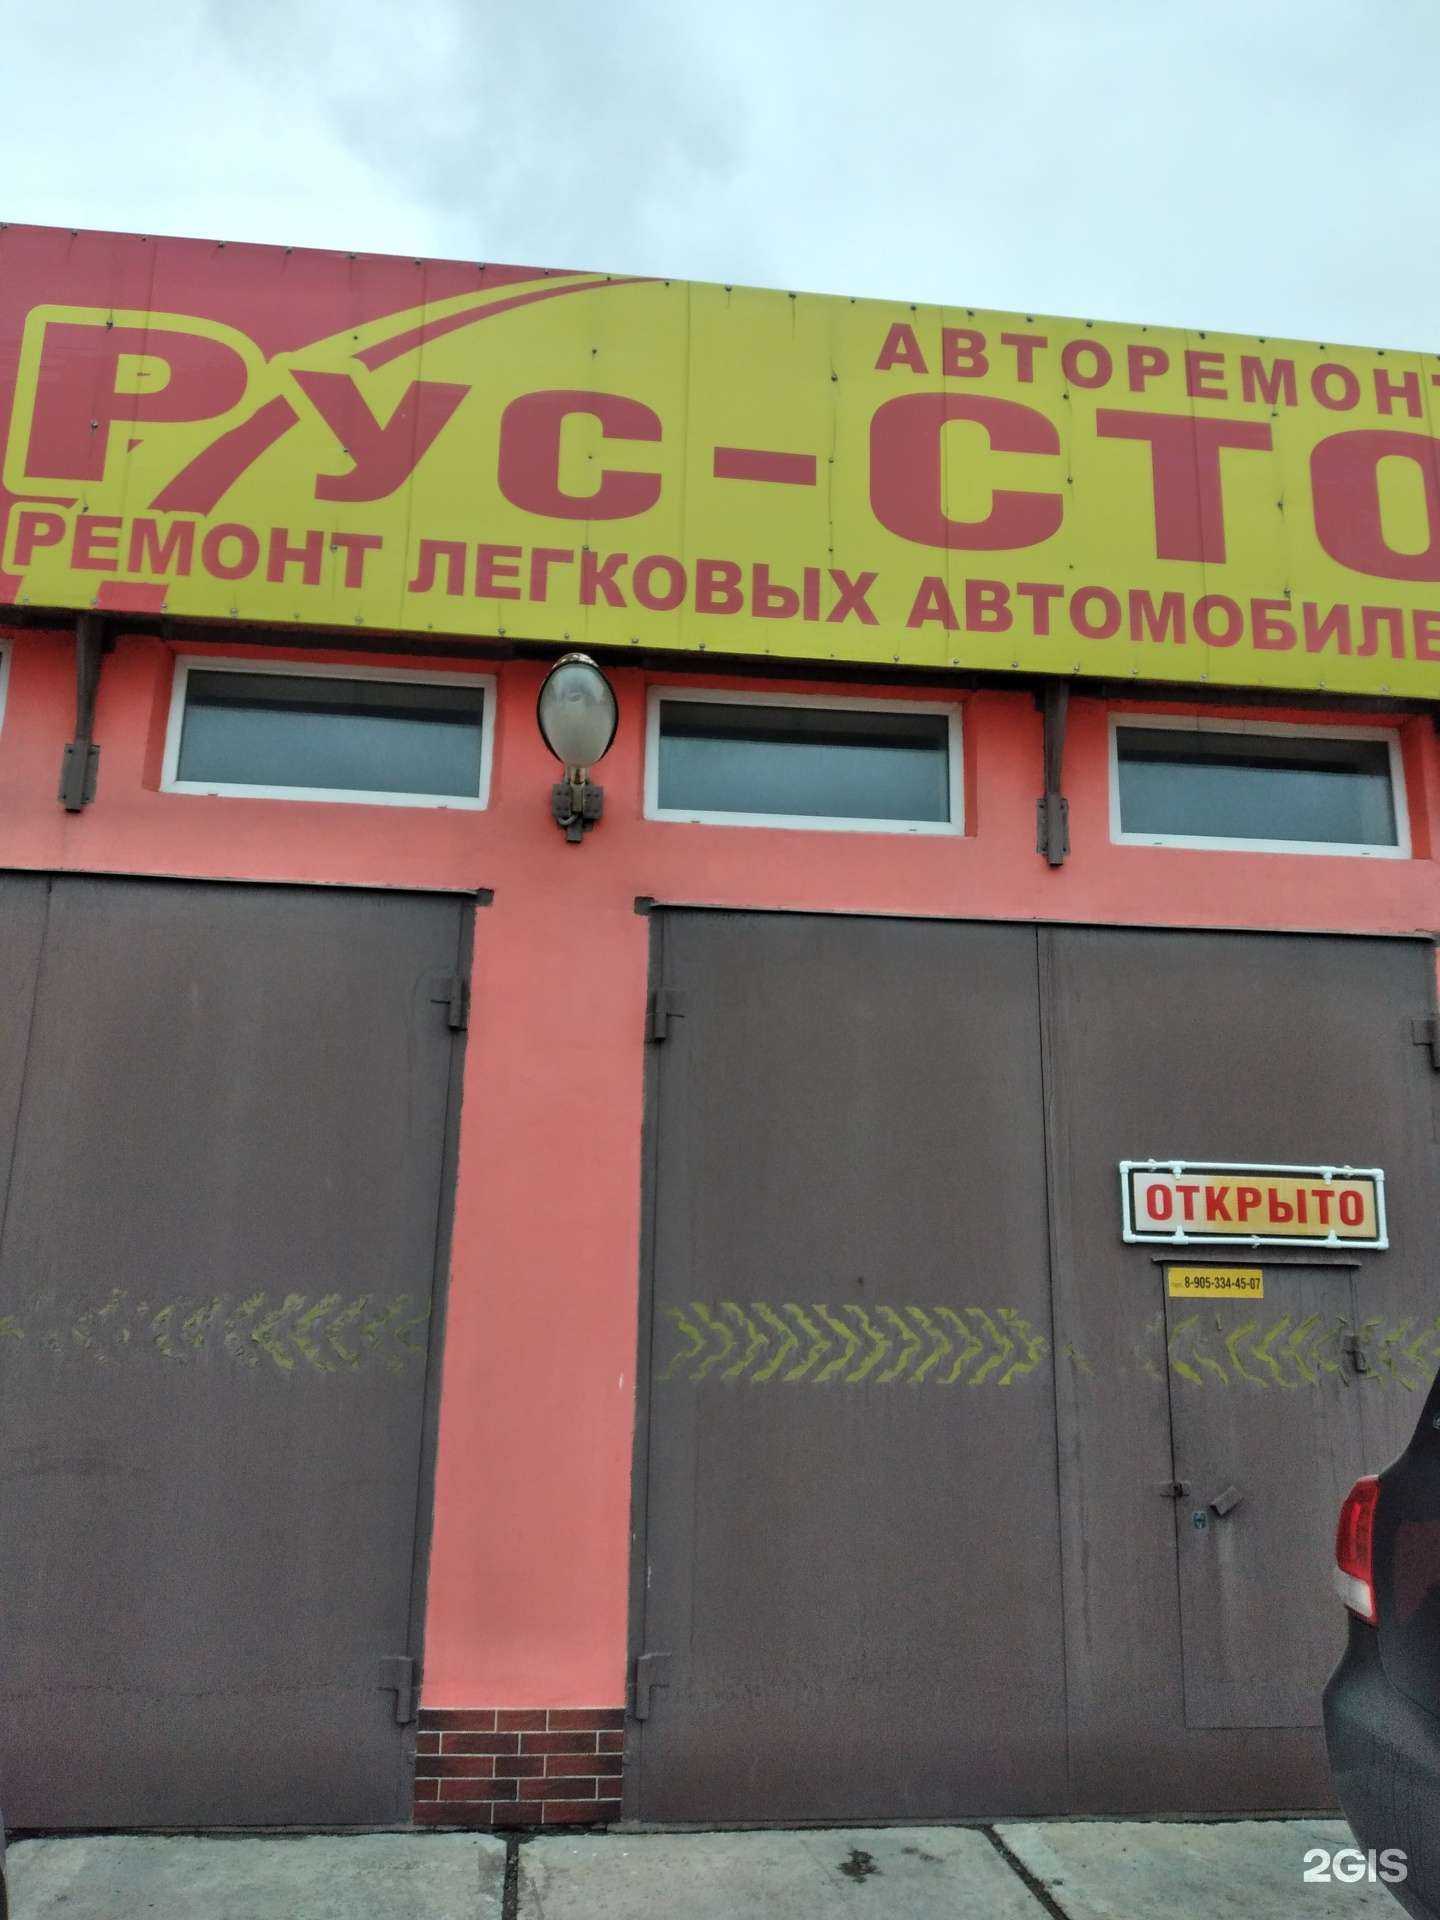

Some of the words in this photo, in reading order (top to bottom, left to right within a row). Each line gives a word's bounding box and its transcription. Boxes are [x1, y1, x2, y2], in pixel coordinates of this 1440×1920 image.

[874, 322, 1440, 418] АВТОРЕМОН
[13, 510, 383, 589] РЕМОНТ
[409, 539, 880, 627] ЛЕГКОВЫХ
[1146, 1184, 1364, 1226] ОТКРЫТО
[1184, 1276, 1260, 1290] 8-905-334-45-07
